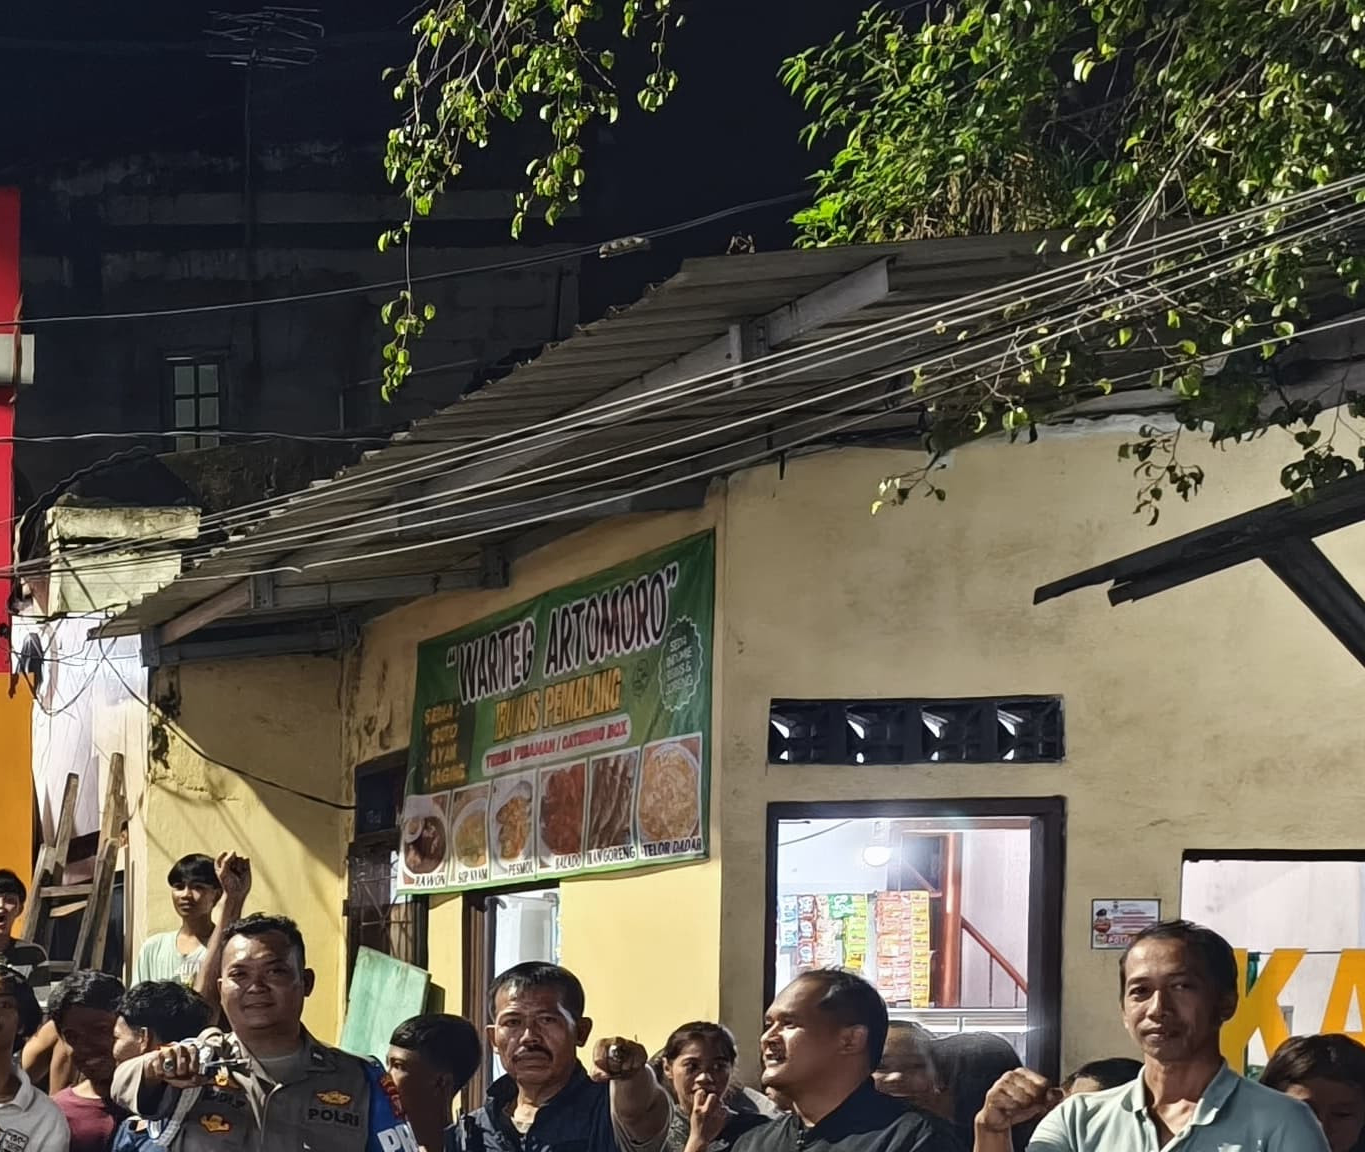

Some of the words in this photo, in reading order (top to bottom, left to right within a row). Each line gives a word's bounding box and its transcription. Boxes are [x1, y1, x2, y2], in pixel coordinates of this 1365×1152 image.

[543, 667, 621, 728] PEMALANG
[643, 841, 670, 857] TELOR
[308, 1108, 360, 1127] POLRI
